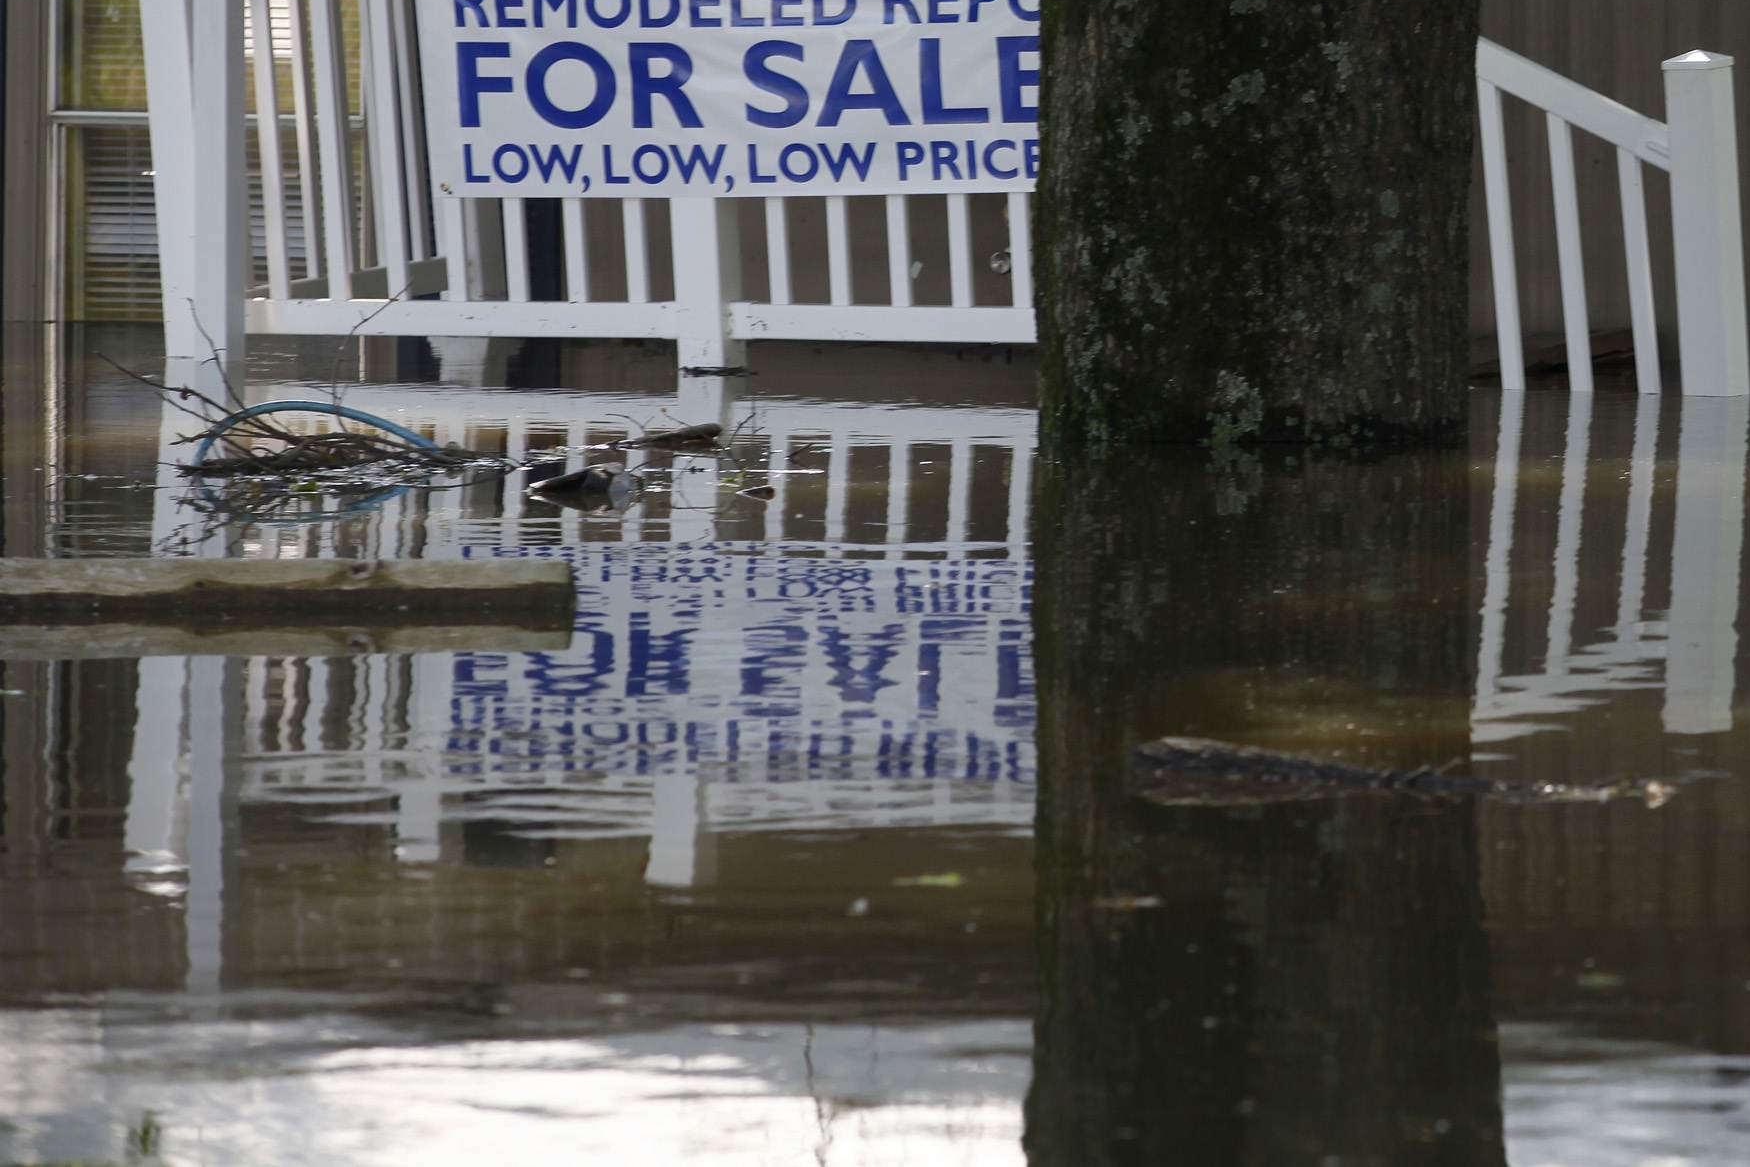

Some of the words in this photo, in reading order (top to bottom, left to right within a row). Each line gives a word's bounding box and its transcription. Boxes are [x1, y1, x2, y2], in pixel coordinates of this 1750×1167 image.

[456, 40, 704, 129] FOR
[743, 34, 1041, 128] SALE
[463, 143, 591, 192] LOW,
[603, 143, 735, 193] LOW,
[748, 141, 876, 184] LOW
